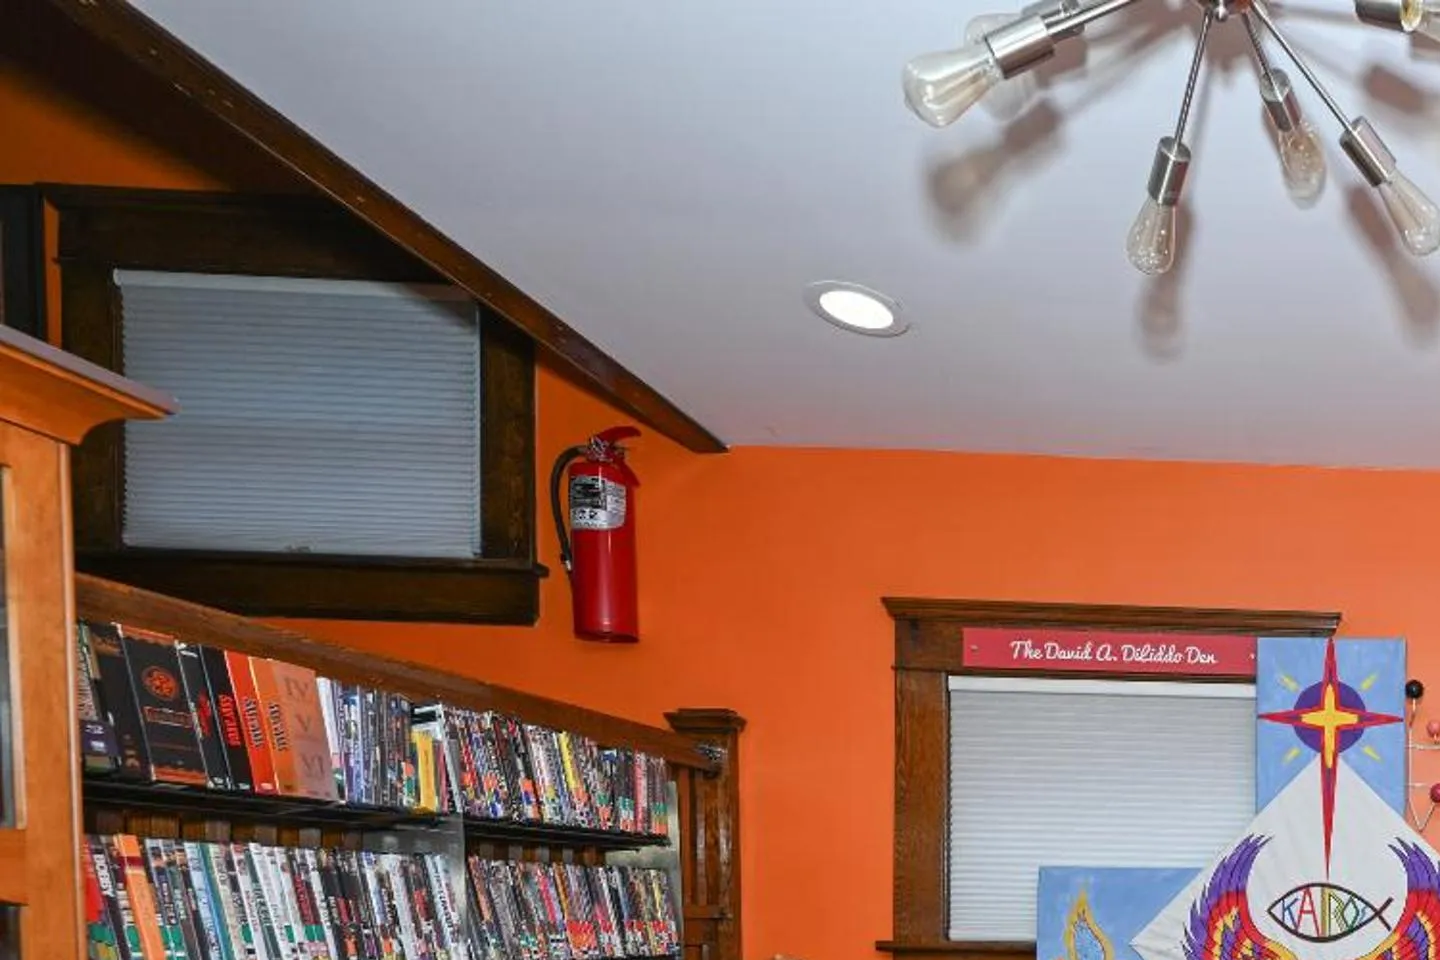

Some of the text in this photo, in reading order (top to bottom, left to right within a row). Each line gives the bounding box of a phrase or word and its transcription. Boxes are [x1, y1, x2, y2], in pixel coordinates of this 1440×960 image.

[1010, 640, 1042, 660] The
[1045, 641, 1094, 661] David
[1096, 645, 1117, 662] A.
[1185, 646, 1218, 664] Den
[93, 854, 115, 897] BOBBY
